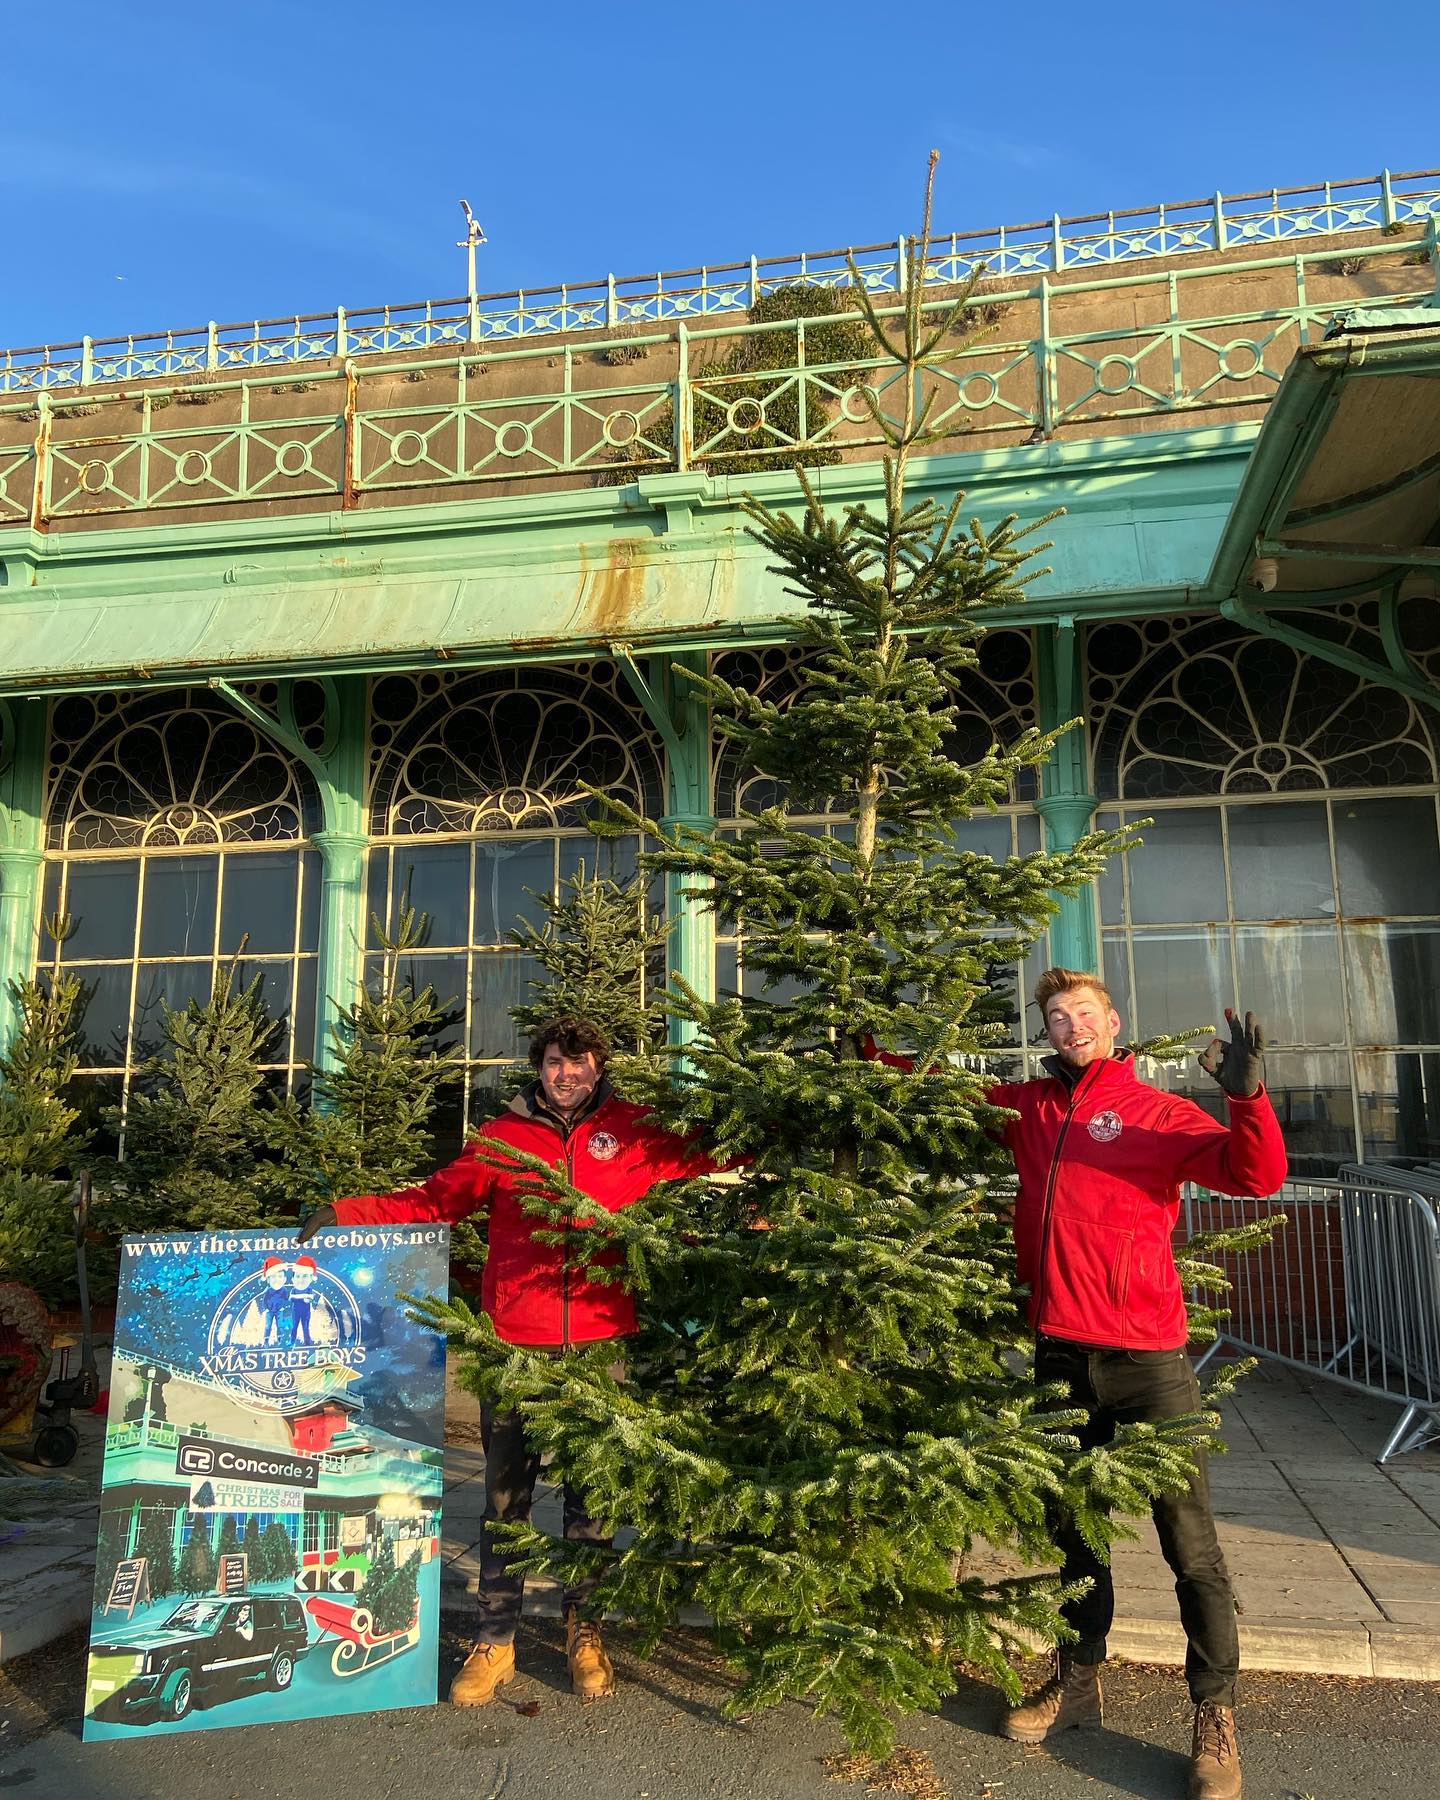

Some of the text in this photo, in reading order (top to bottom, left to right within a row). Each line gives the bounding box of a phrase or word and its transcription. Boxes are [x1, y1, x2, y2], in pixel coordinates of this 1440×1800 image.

[198, 1346, 366, 1377] XMAS TREE BOYS
[218, 1452, 302, 1477] Concorde
[305, 1466, 313, 1479] 2
[216, 1483, 281, 1496] CHRISTMAS
[284, 1490, 301, 1500] FOR
[215, 1492, 279, 1508] TREES
[280, 1499, 303, 1508] SALE
